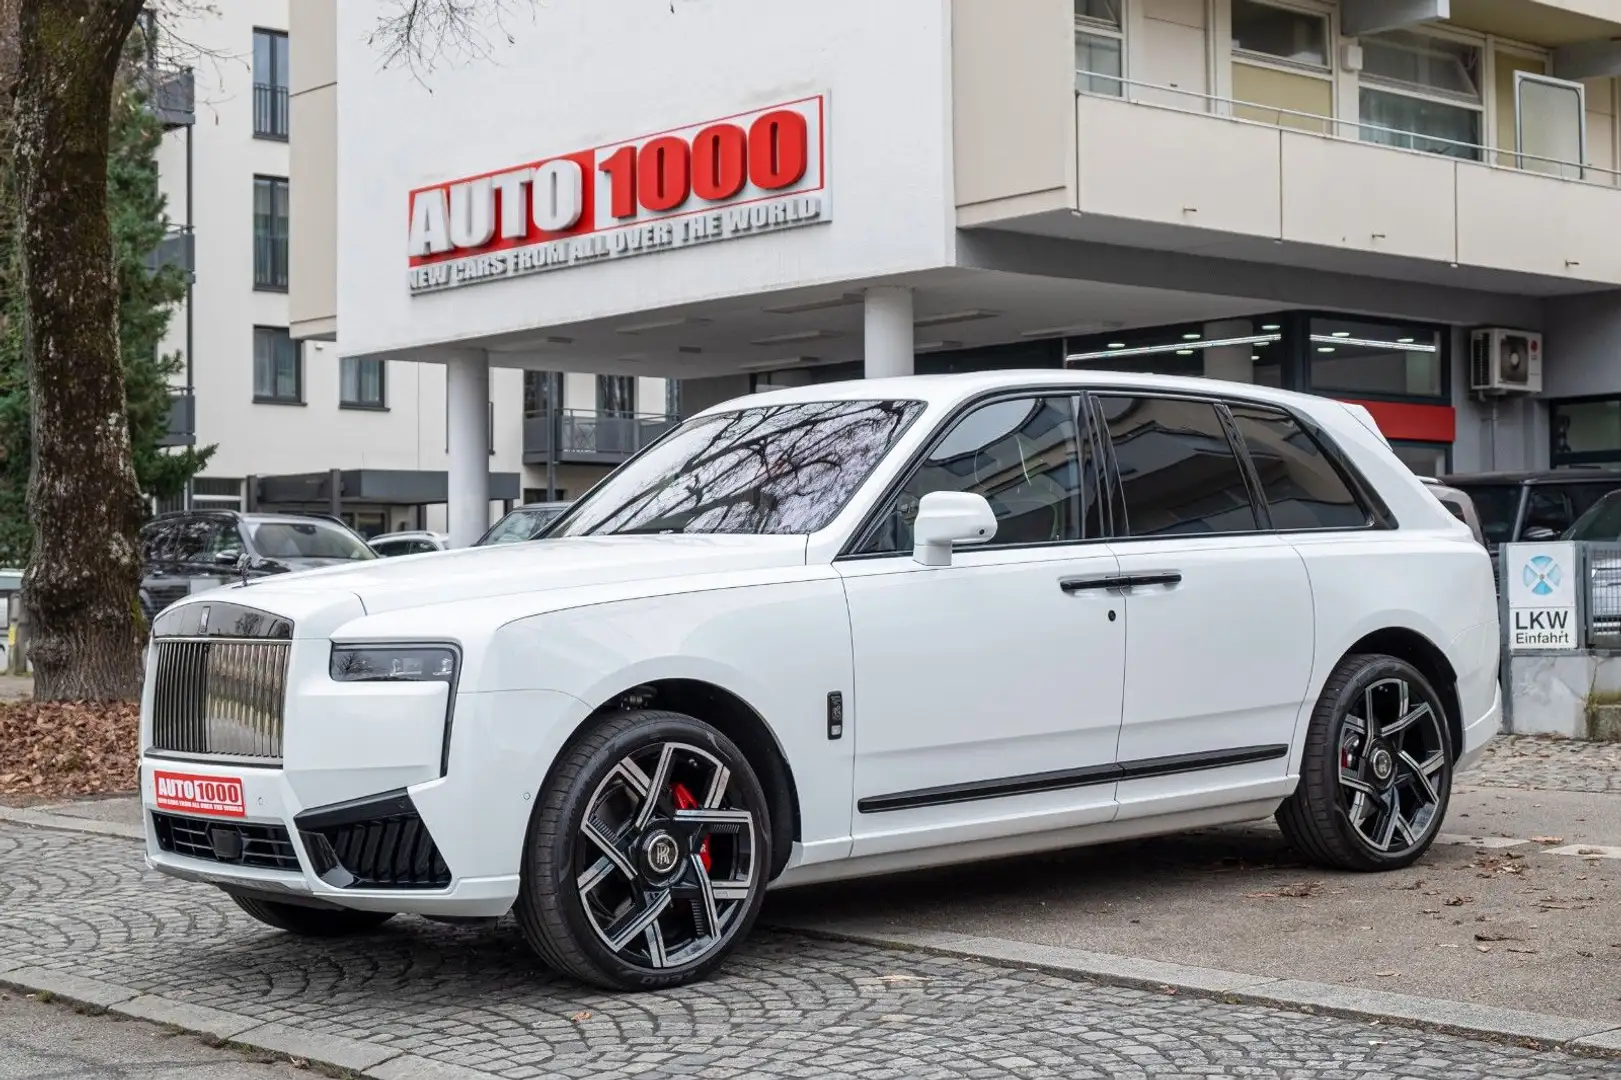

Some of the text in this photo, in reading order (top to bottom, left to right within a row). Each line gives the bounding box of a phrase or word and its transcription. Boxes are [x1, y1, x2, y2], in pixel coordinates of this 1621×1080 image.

[408, 109, 808, 258] AUTO 1000
[409, 198, 821, 290] NEW CARS FROM ALL OVER THE WORLD
[1515, 611, 1568, 630] LKW
[1516, 631, 1569, 644] Einfahrt
[158, 777, 239, 803] AUTO 1000
